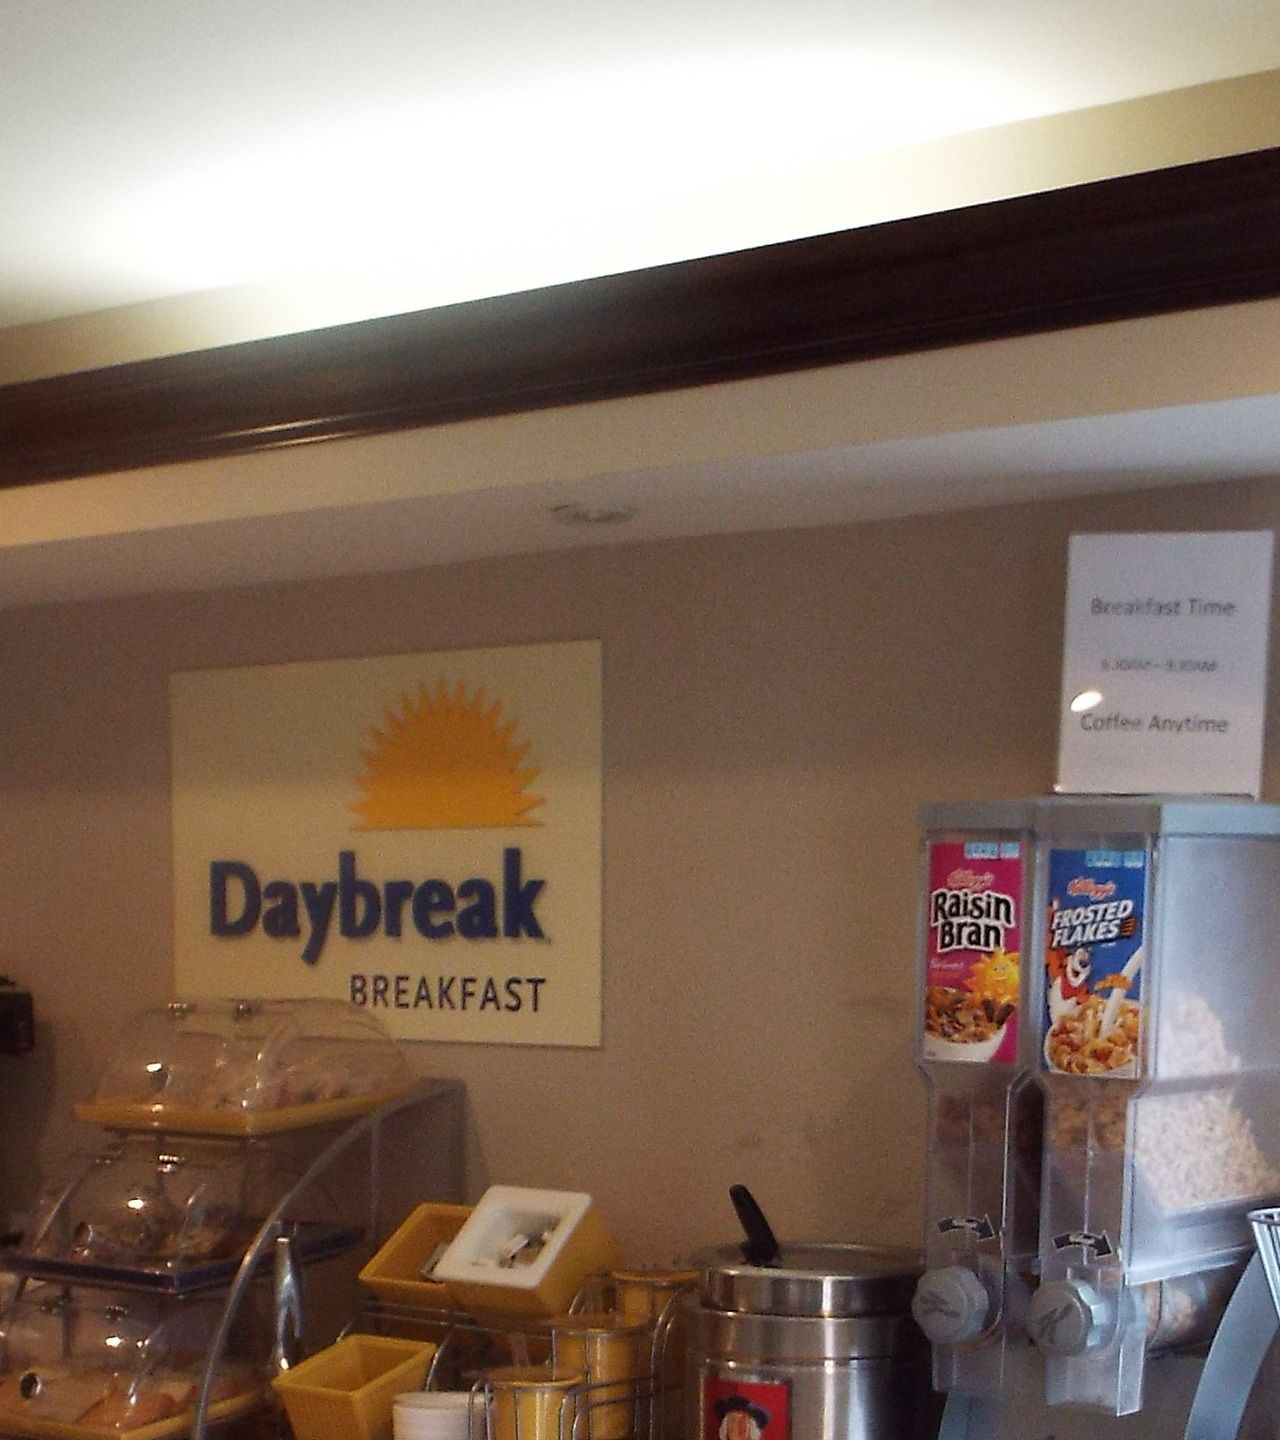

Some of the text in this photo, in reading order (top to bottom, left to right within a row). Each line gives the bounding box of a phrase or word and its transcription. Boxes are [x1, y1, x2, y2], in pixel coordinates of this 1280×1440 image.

[1091, 598, 1238, 616] Breakfast Time
[1080, 712, 1229, 733] Coffee Anytime
[208, 846, 548, 966] Daybreak
[932, 890, 1013, 926] Raisin
[1051, 899, 1134, 930] FROSTED
[939, 920, 1002, 950] Bran
[1051, 919, 1122, 949] FLAKES
[348, 972, 547, 1014] BREAKFAST
